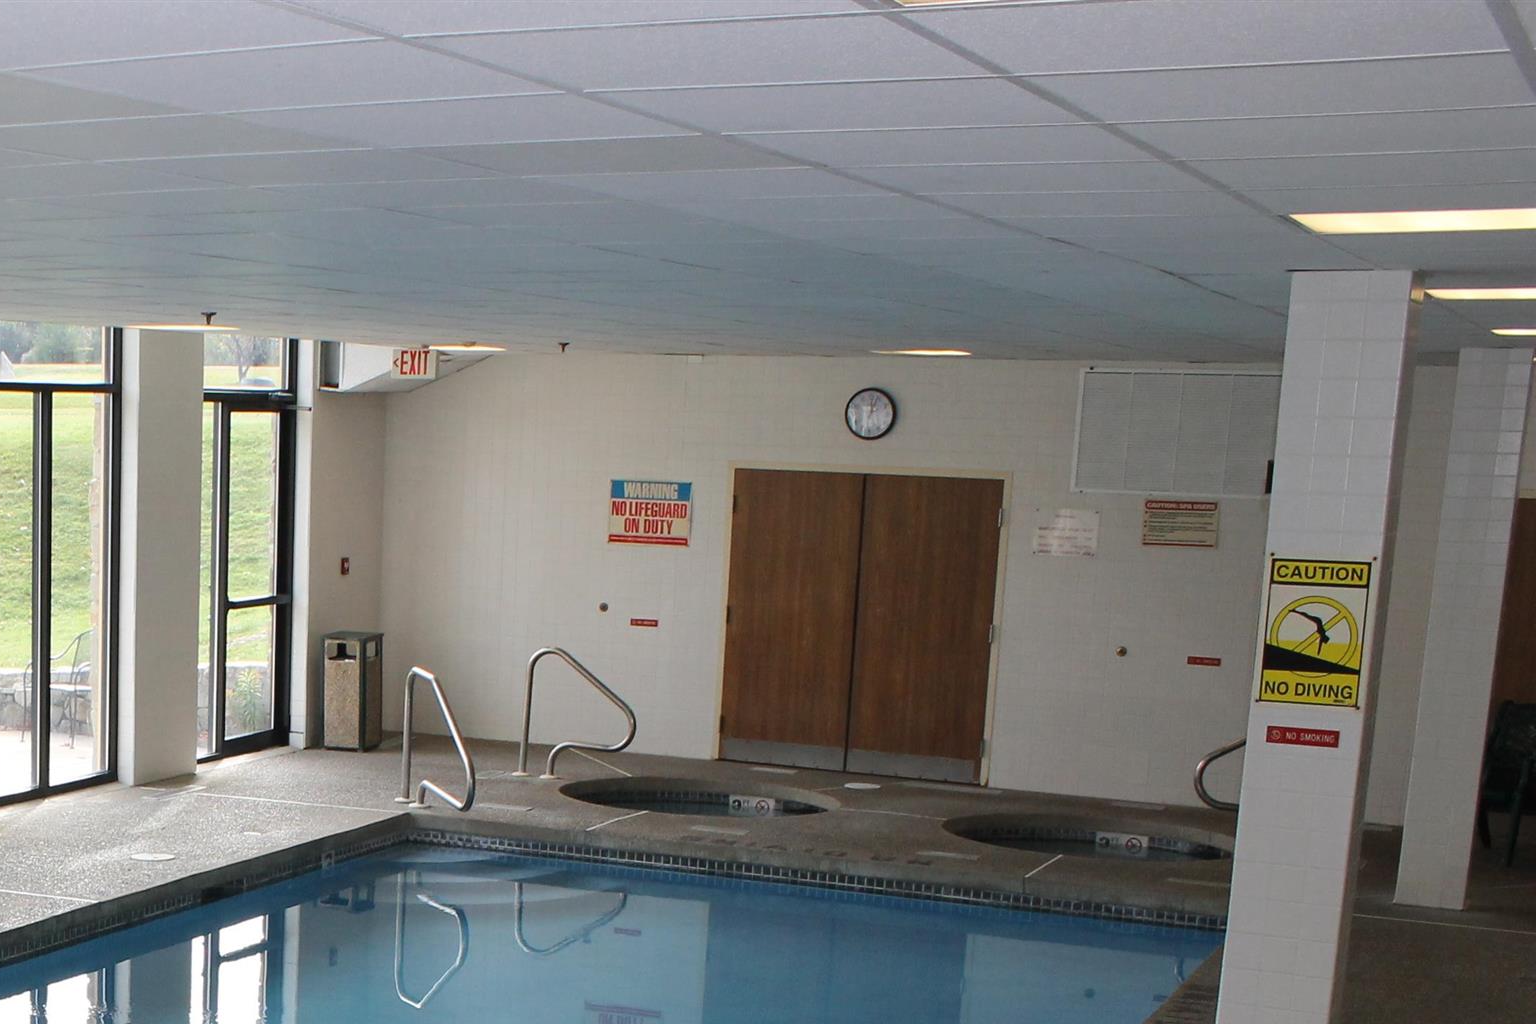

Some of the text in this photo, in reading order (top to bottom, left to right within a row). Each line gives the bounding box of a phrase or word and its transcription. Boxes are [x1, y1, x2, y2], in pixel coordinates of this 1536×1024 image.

[400, 350, 430, 375] EXIT
[624, 482, 678, 499] WARNING
[611, 500, 688, 519] NO LIFEGUARD
[624, 517, 673, 535] ON DUTY
[1276, 564, 1364, 582] CAUTION
[1264, 681, 1353, 700] NO DIVING
[1285, 732, 1335, 744] NO SMOKING
